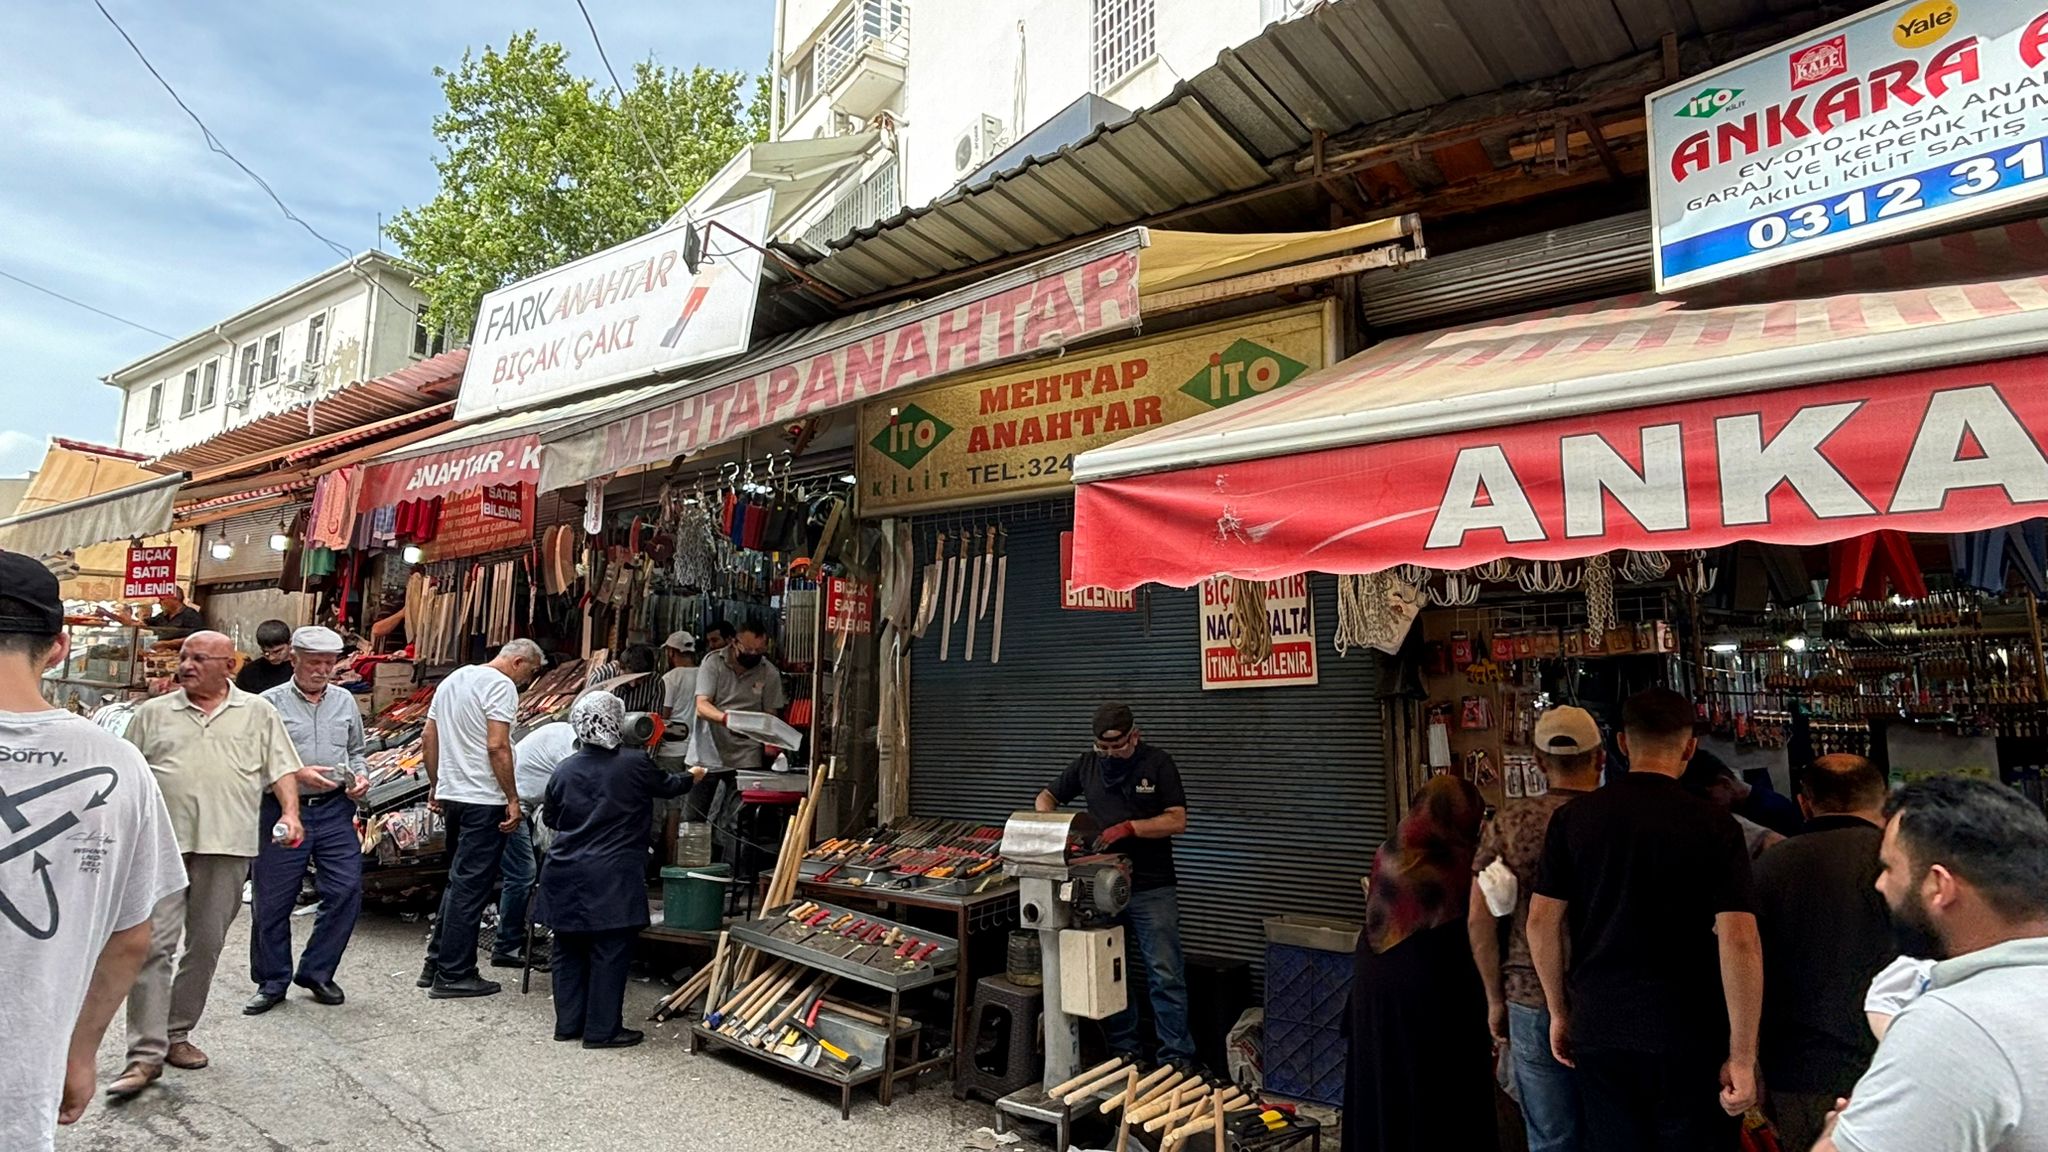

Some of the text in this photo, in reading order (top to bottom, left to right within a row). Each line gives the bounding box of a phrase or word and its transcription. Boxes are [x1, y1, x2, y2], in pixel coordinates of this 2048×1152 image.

[1898, 11, 1952, 38] Yale
[1797, 51, 1839, 79] KALE
[1671, 35, 1979, 183] ANKARA
[1686, 176, 1772, 211] GARAJ
[1784, 160, 1821, 180] VE
[1835, 116, 1966, 166] KEPENK
[1739, 104, 1949, 178] EV-OTO-KASA
[1749, 118, 2026, 209] AKILLI KİLİT SATIŞ
[1747, 177, 1925, 250] 0312
[492, 315, 640, 385] BIÇAK ÇAKI
[979, 358, 1149, 416] MEHTAP
[966, 395, 1163, 453] ANAHTAR
[406, 450, 504, 490] ANAHTAR
[488, 486, 517, 503] SATIR
[1423, 383, 2048, 550] ANKA
[483, 500, 521, 521] BİLENİR
[132, 549, 171, 564] BIÇAK
[133, 566, 169, 579] SATIR
[125, 580, 175, 596] BİLENİR
